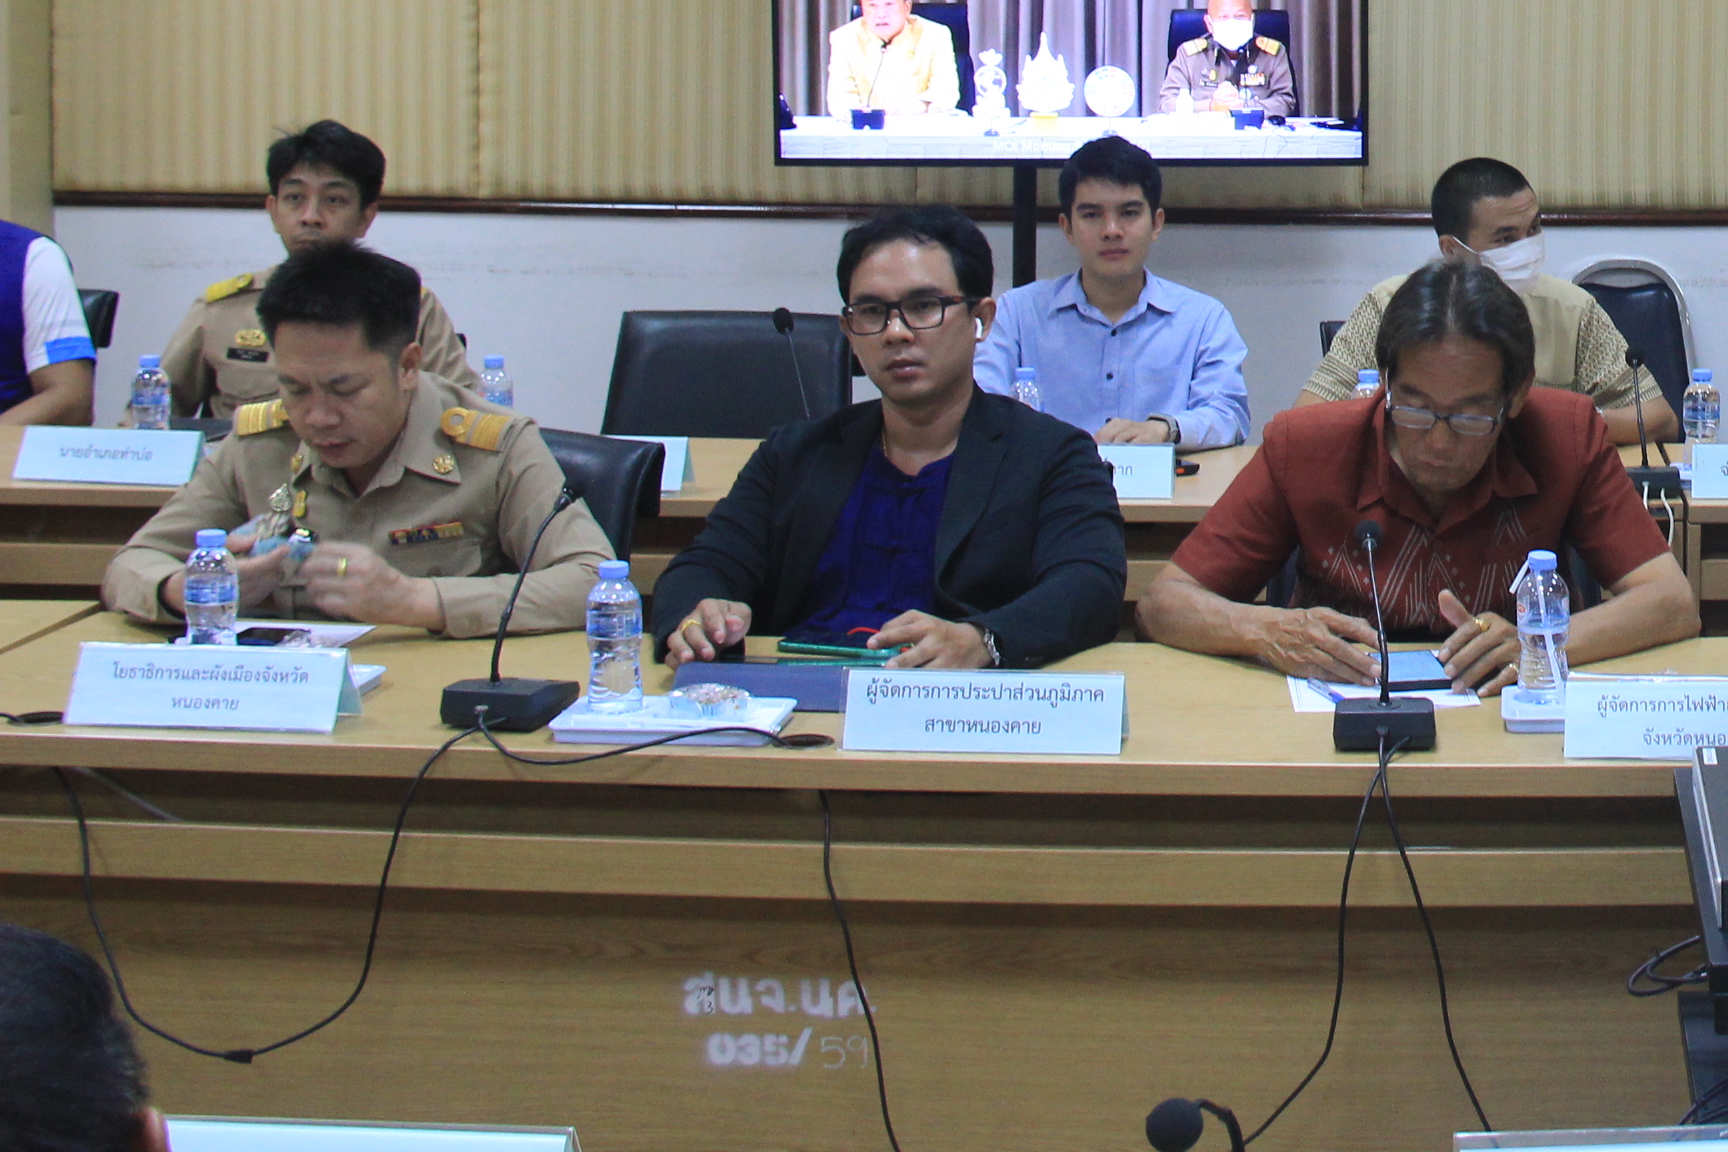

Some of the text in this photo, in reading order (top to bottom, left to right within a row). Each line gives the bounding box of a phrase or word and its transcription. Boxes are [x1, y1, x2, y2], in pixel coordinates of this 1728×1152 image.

[113, 661, 310, 684] โยธาธิการและผังเมืองจังหวัด
[866, 677, 1105, 709] ผู้จัดการการประปาส่วนภูมิภาค
[171, 696, 240, 711] หนองคาย
[924, 717, 1042, 735] สาขาหนองคาย
